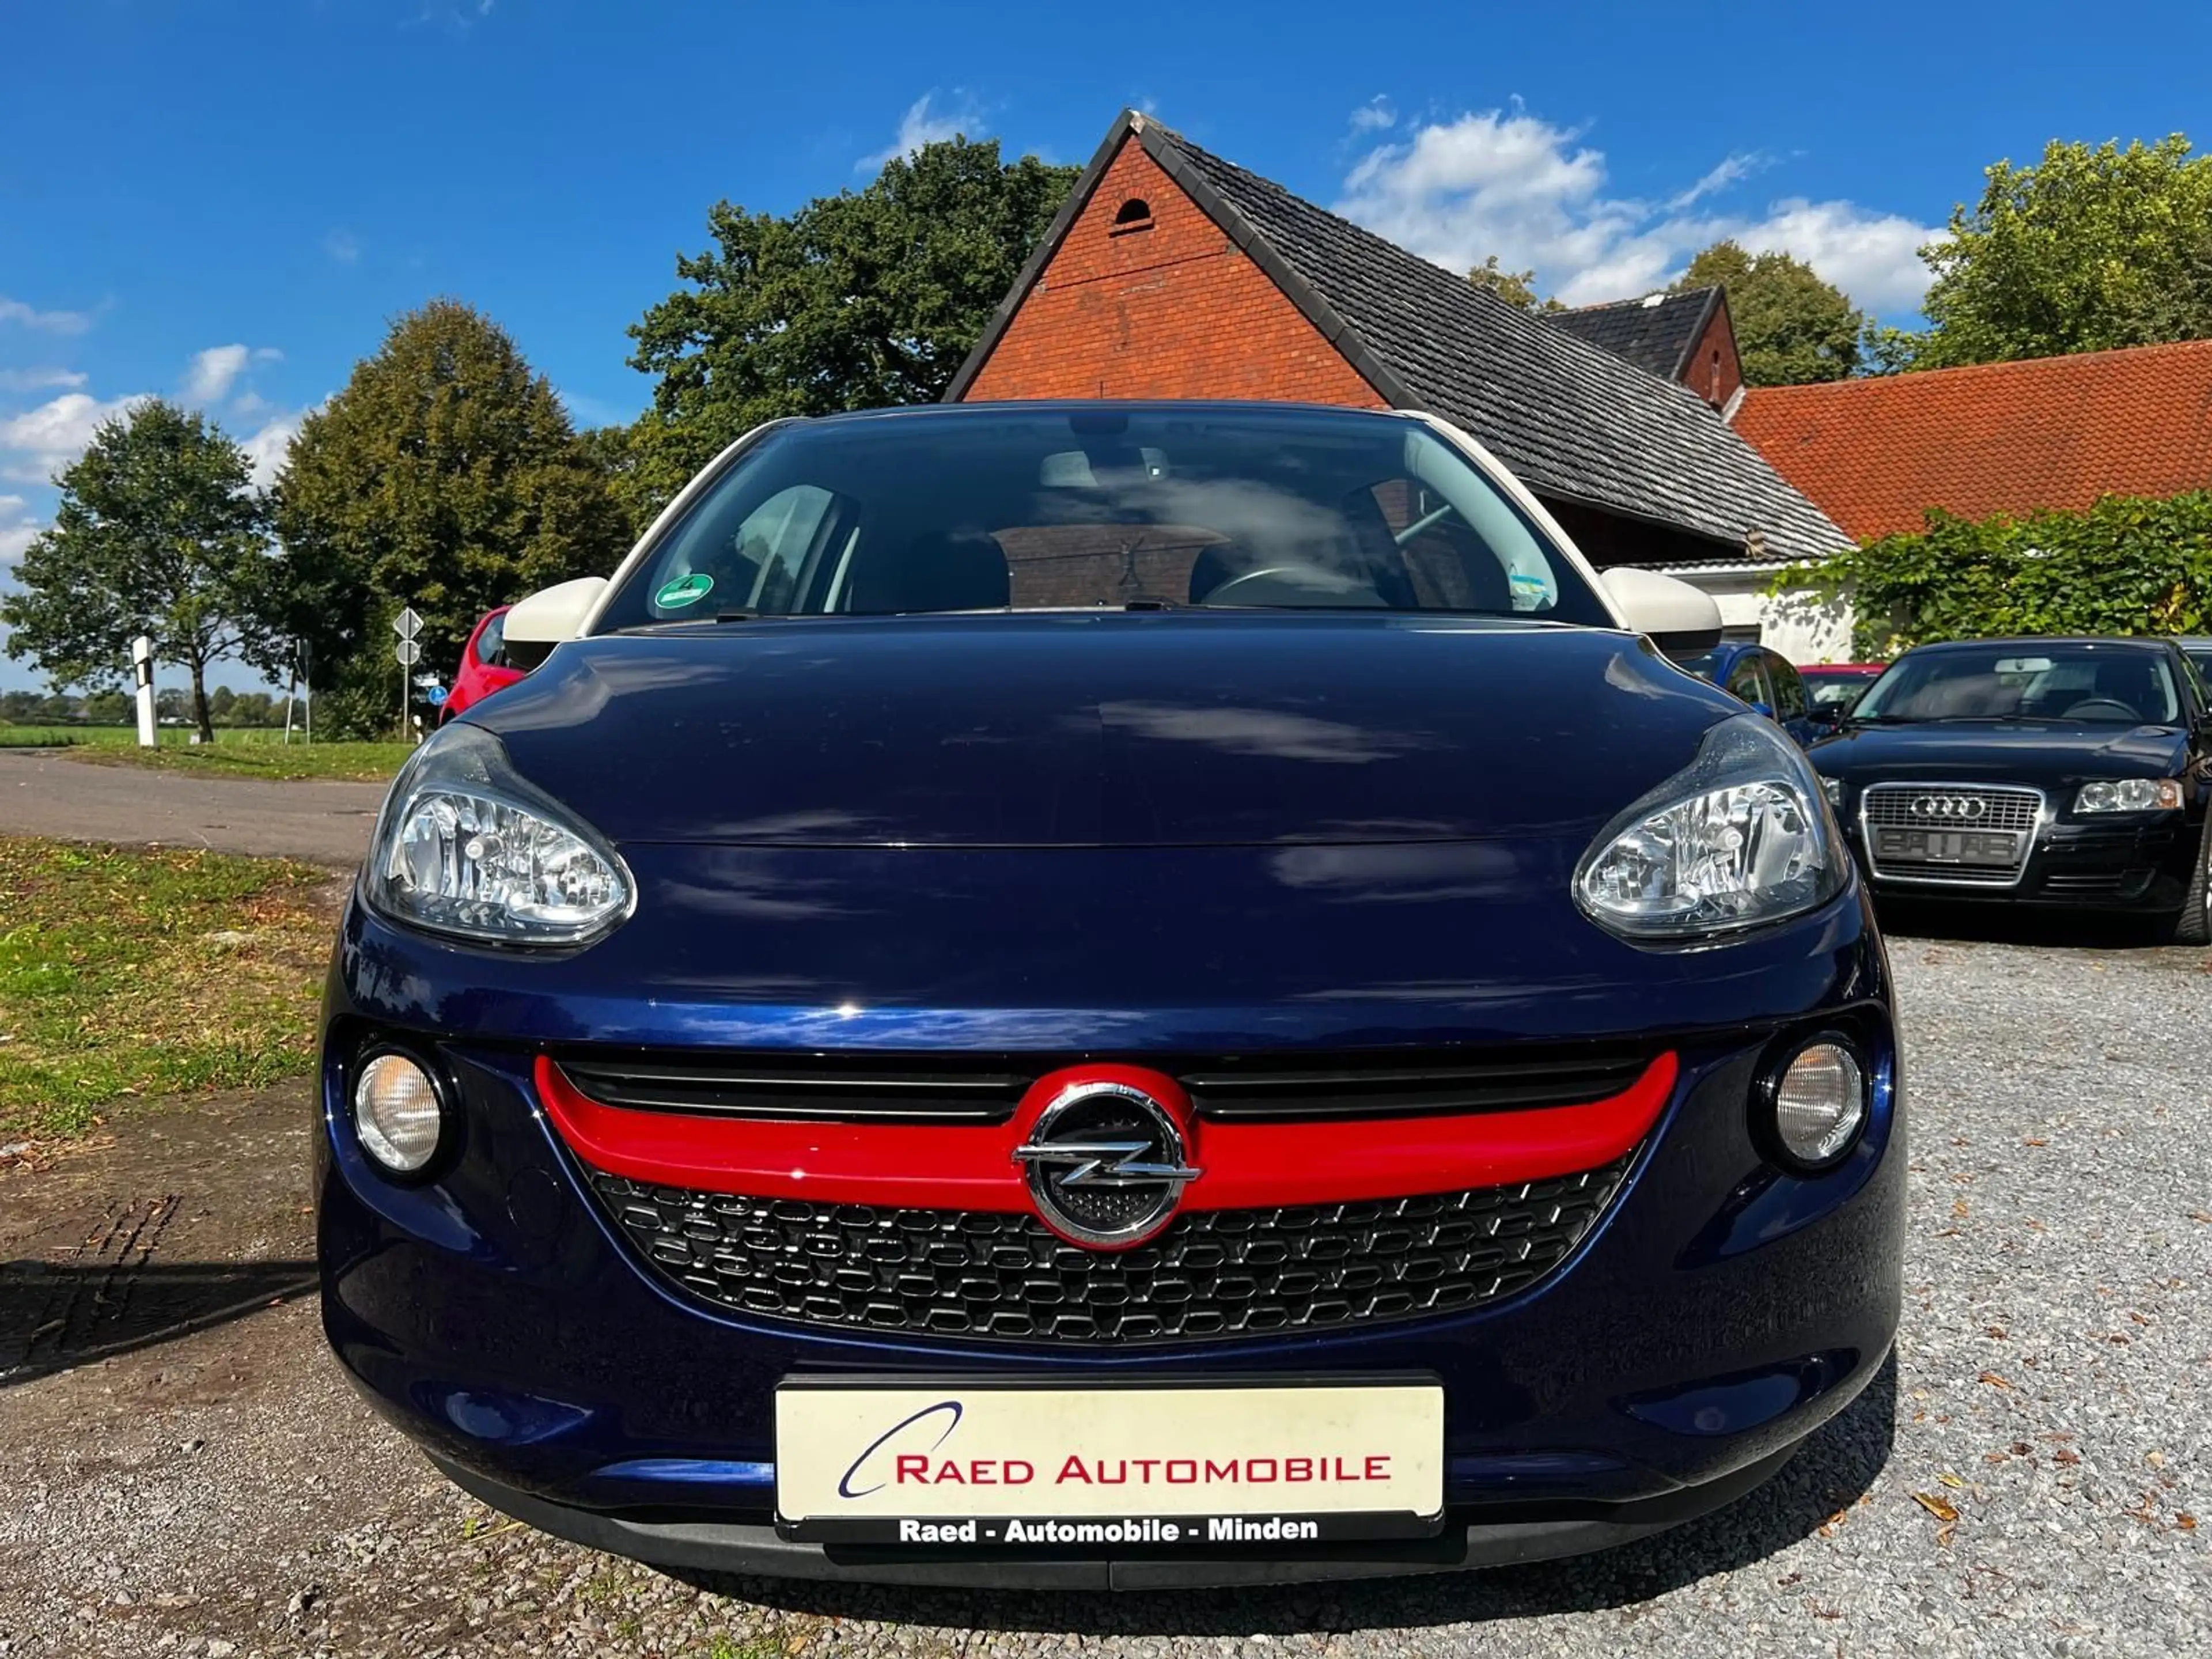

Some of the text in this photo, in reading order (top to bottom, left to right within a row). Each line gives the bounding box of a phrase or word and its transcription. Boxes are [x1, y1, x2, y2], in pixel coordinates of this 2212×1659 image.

[678, 576, 694, 590] 4
[900, 1519, 976, 1542] Raed
[1004, 1518, 1180, 1542] Automobile
[1208, 1517, 1318, 1541] Minden
